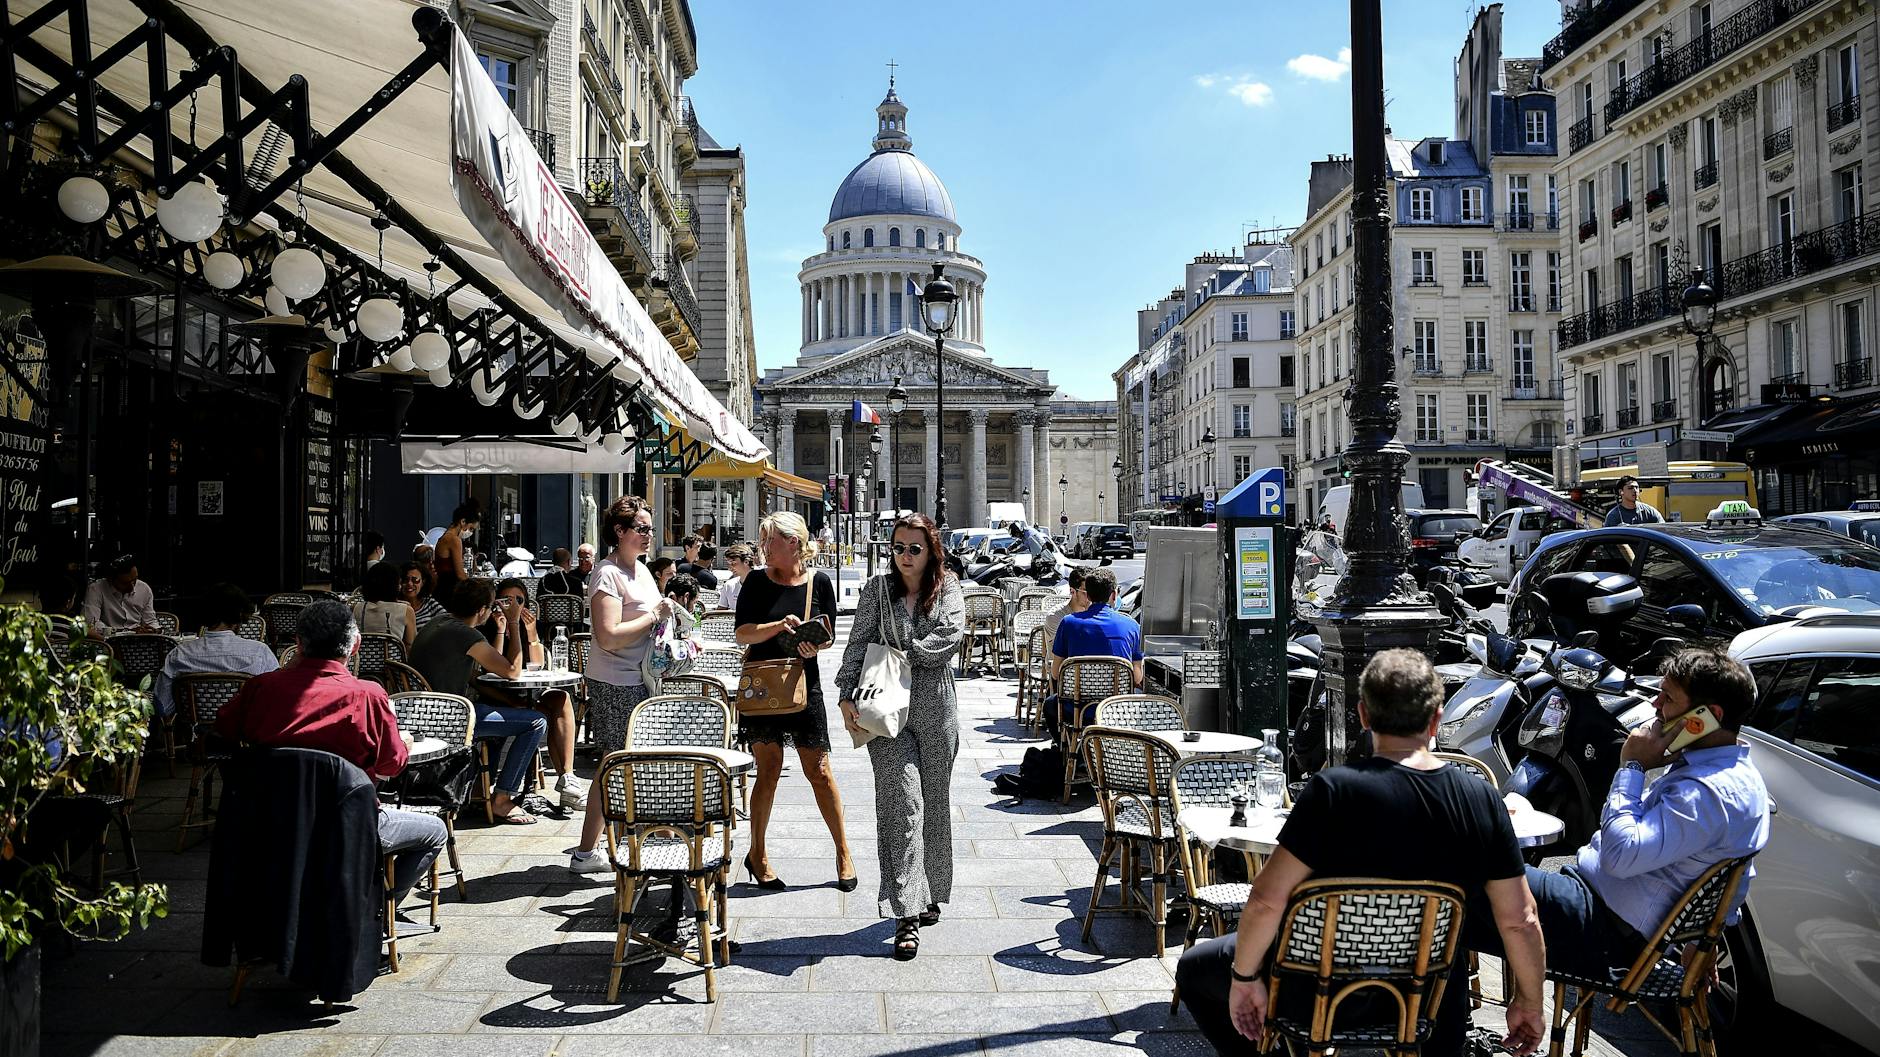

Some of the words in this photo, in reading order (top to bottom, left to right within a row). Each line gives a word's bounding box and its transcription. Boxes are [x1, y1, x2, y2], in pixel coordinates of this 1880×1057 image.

[1418, 457, 1442, 465] BNP
[1444, 457, 1479, 465] PARIB
[8, 478, 42, 512] Plat
[1260, 481, 1281, 516] P
[1725, 503, 1748, 513] TAXI
[14, 513, 29, 533] du
[308, 515, 329, 532] VINS
[3, 535, 39, 576] Jour
